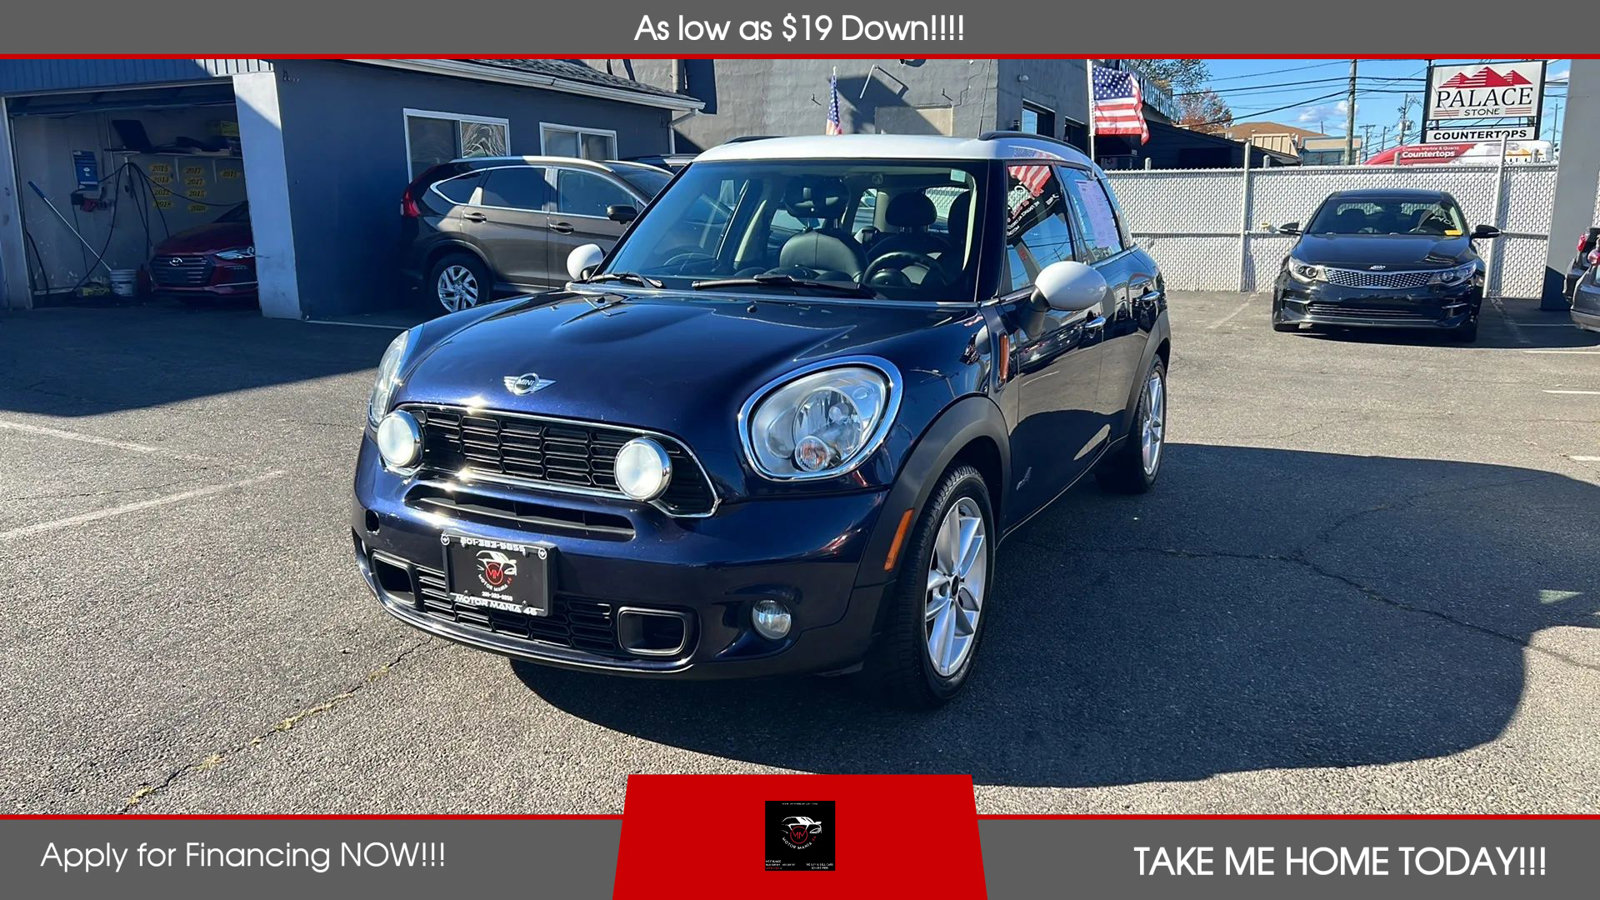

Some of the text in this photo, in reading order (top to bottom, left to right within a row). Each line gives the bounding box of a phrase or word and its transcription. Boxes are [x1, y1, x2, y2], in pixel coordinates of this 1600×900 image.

[1435, 87, 1534, 109] PALACE
[1464, 108, 1500, 117] STONE
[1433, 129, 1528, 141] COUNTERTOPS
[454, 593, 489, 608] MOTOR
[489, 599, 522, 614] MANIA
